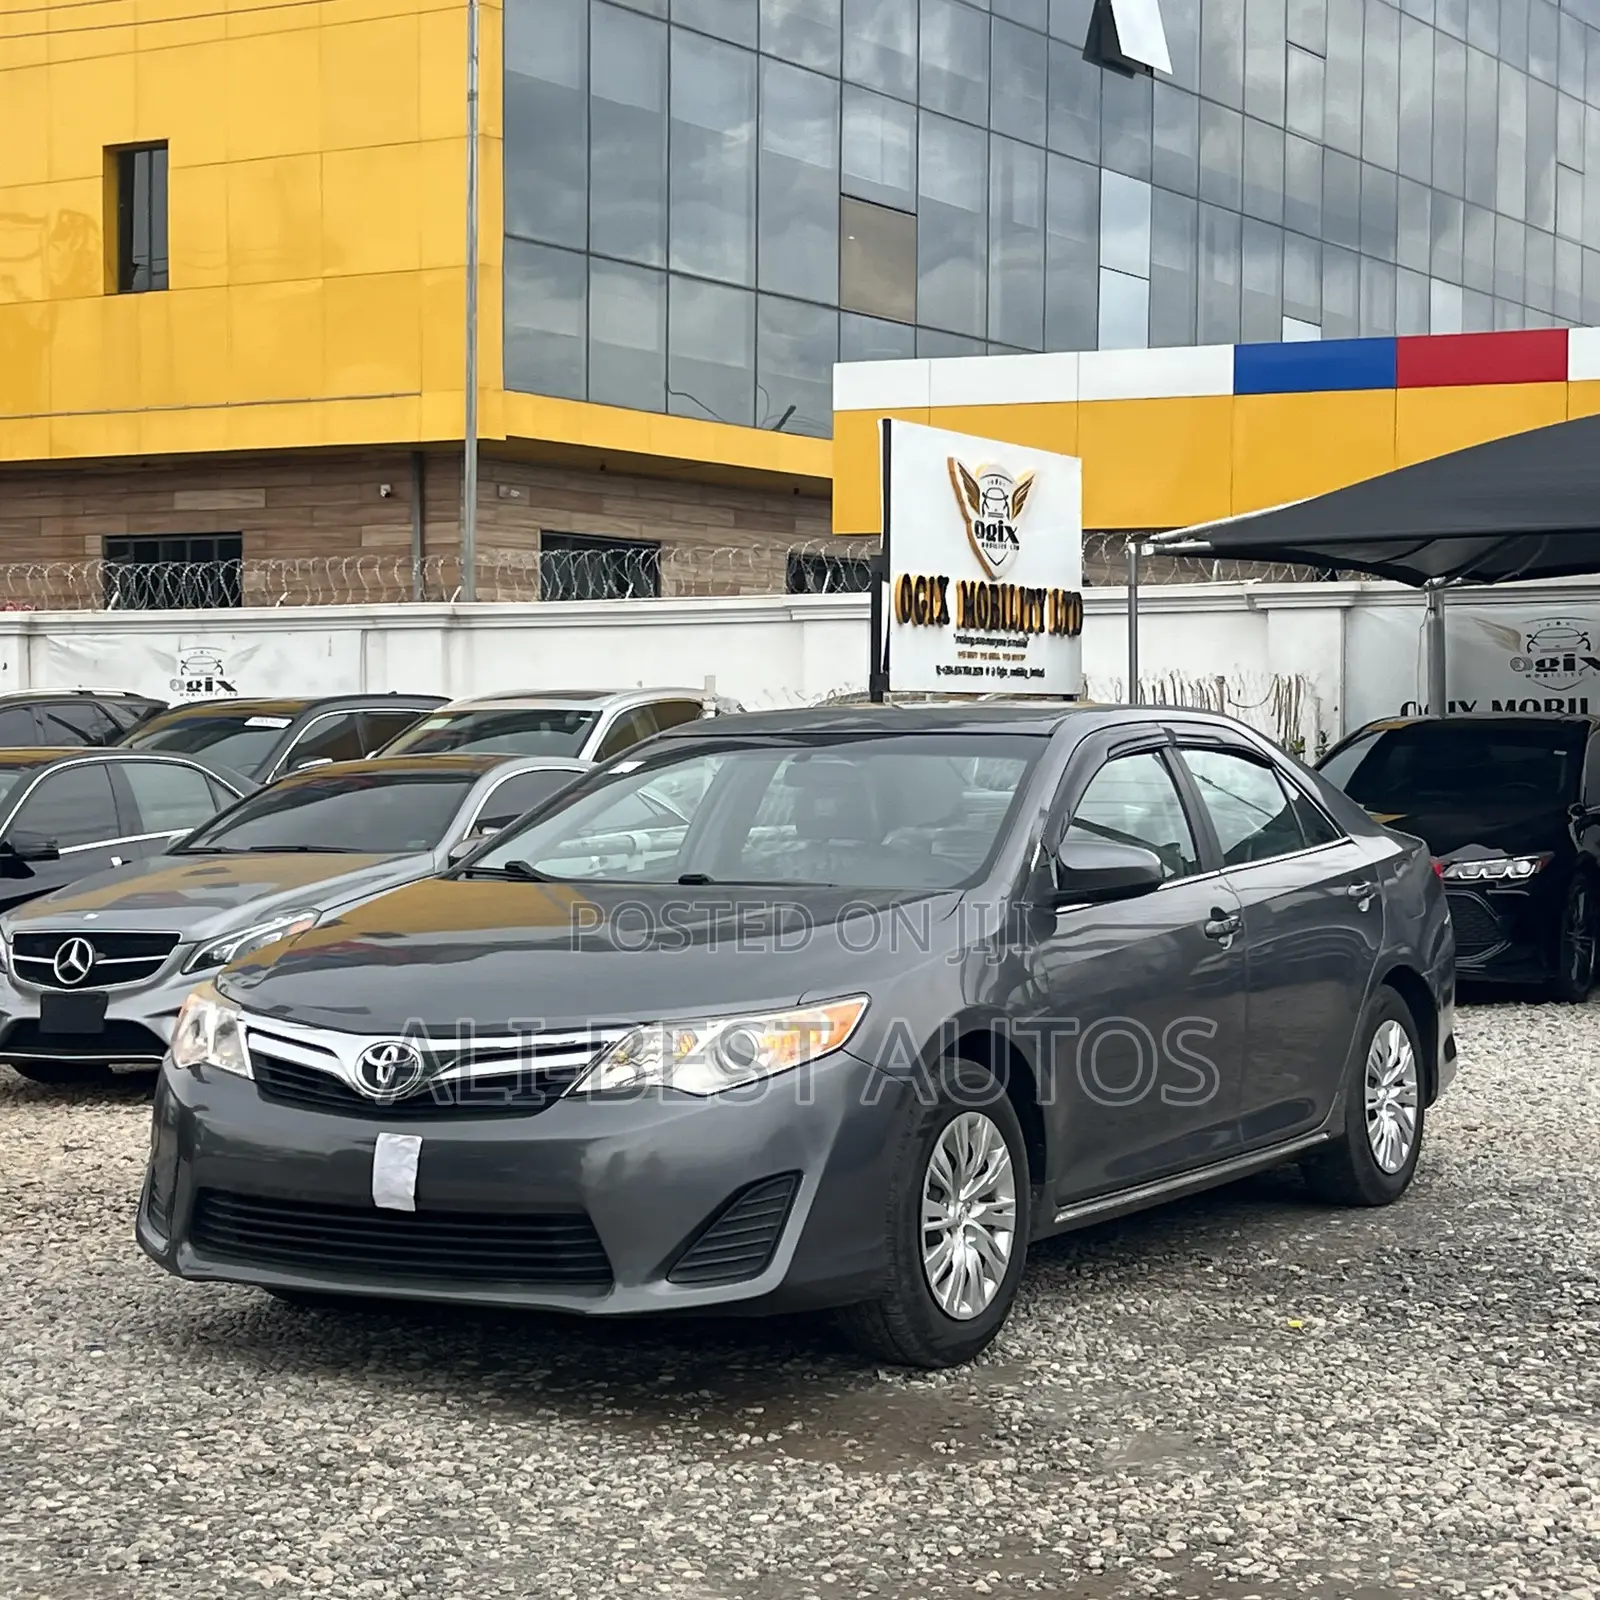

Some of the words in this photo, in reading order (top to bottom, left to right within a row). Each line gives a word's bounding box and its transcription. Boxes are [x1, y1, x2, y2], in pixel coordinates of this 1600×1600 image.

[895, 573, 950, 627] OGIX
[956, 580, 1047, 634] MOBILITY
[1048, 588, 1083, 636] LTD
